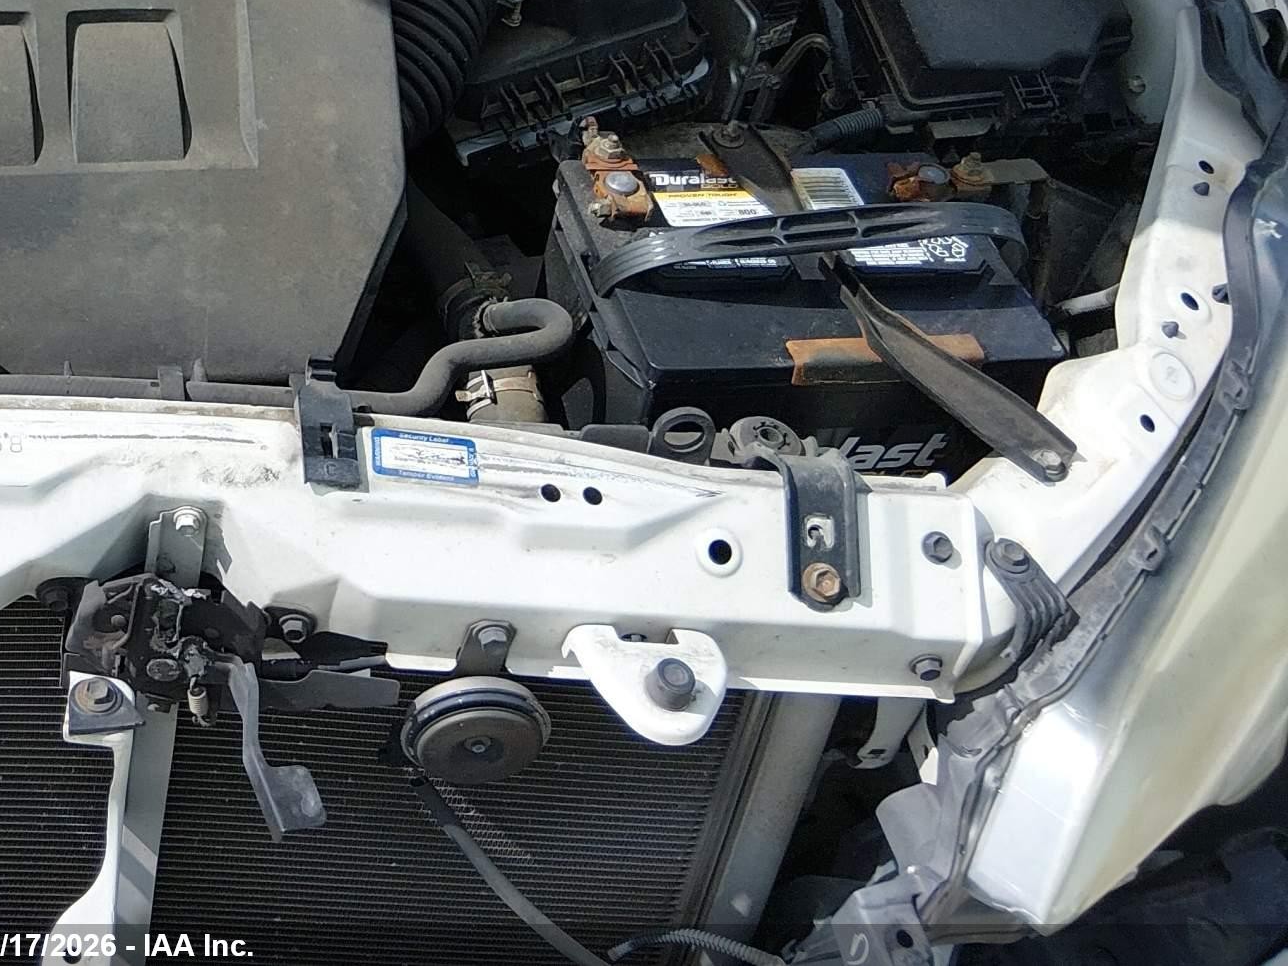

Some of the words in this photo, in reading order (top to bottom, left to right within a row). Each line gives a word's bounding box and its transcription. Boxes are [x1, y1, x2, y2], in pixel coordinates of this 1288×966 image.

[649, 173, 737, 186] Duralast
[399, 432, 428, 442] Security
[428, 435, 450, 443] Label
[839, 434, 947, 469] last
